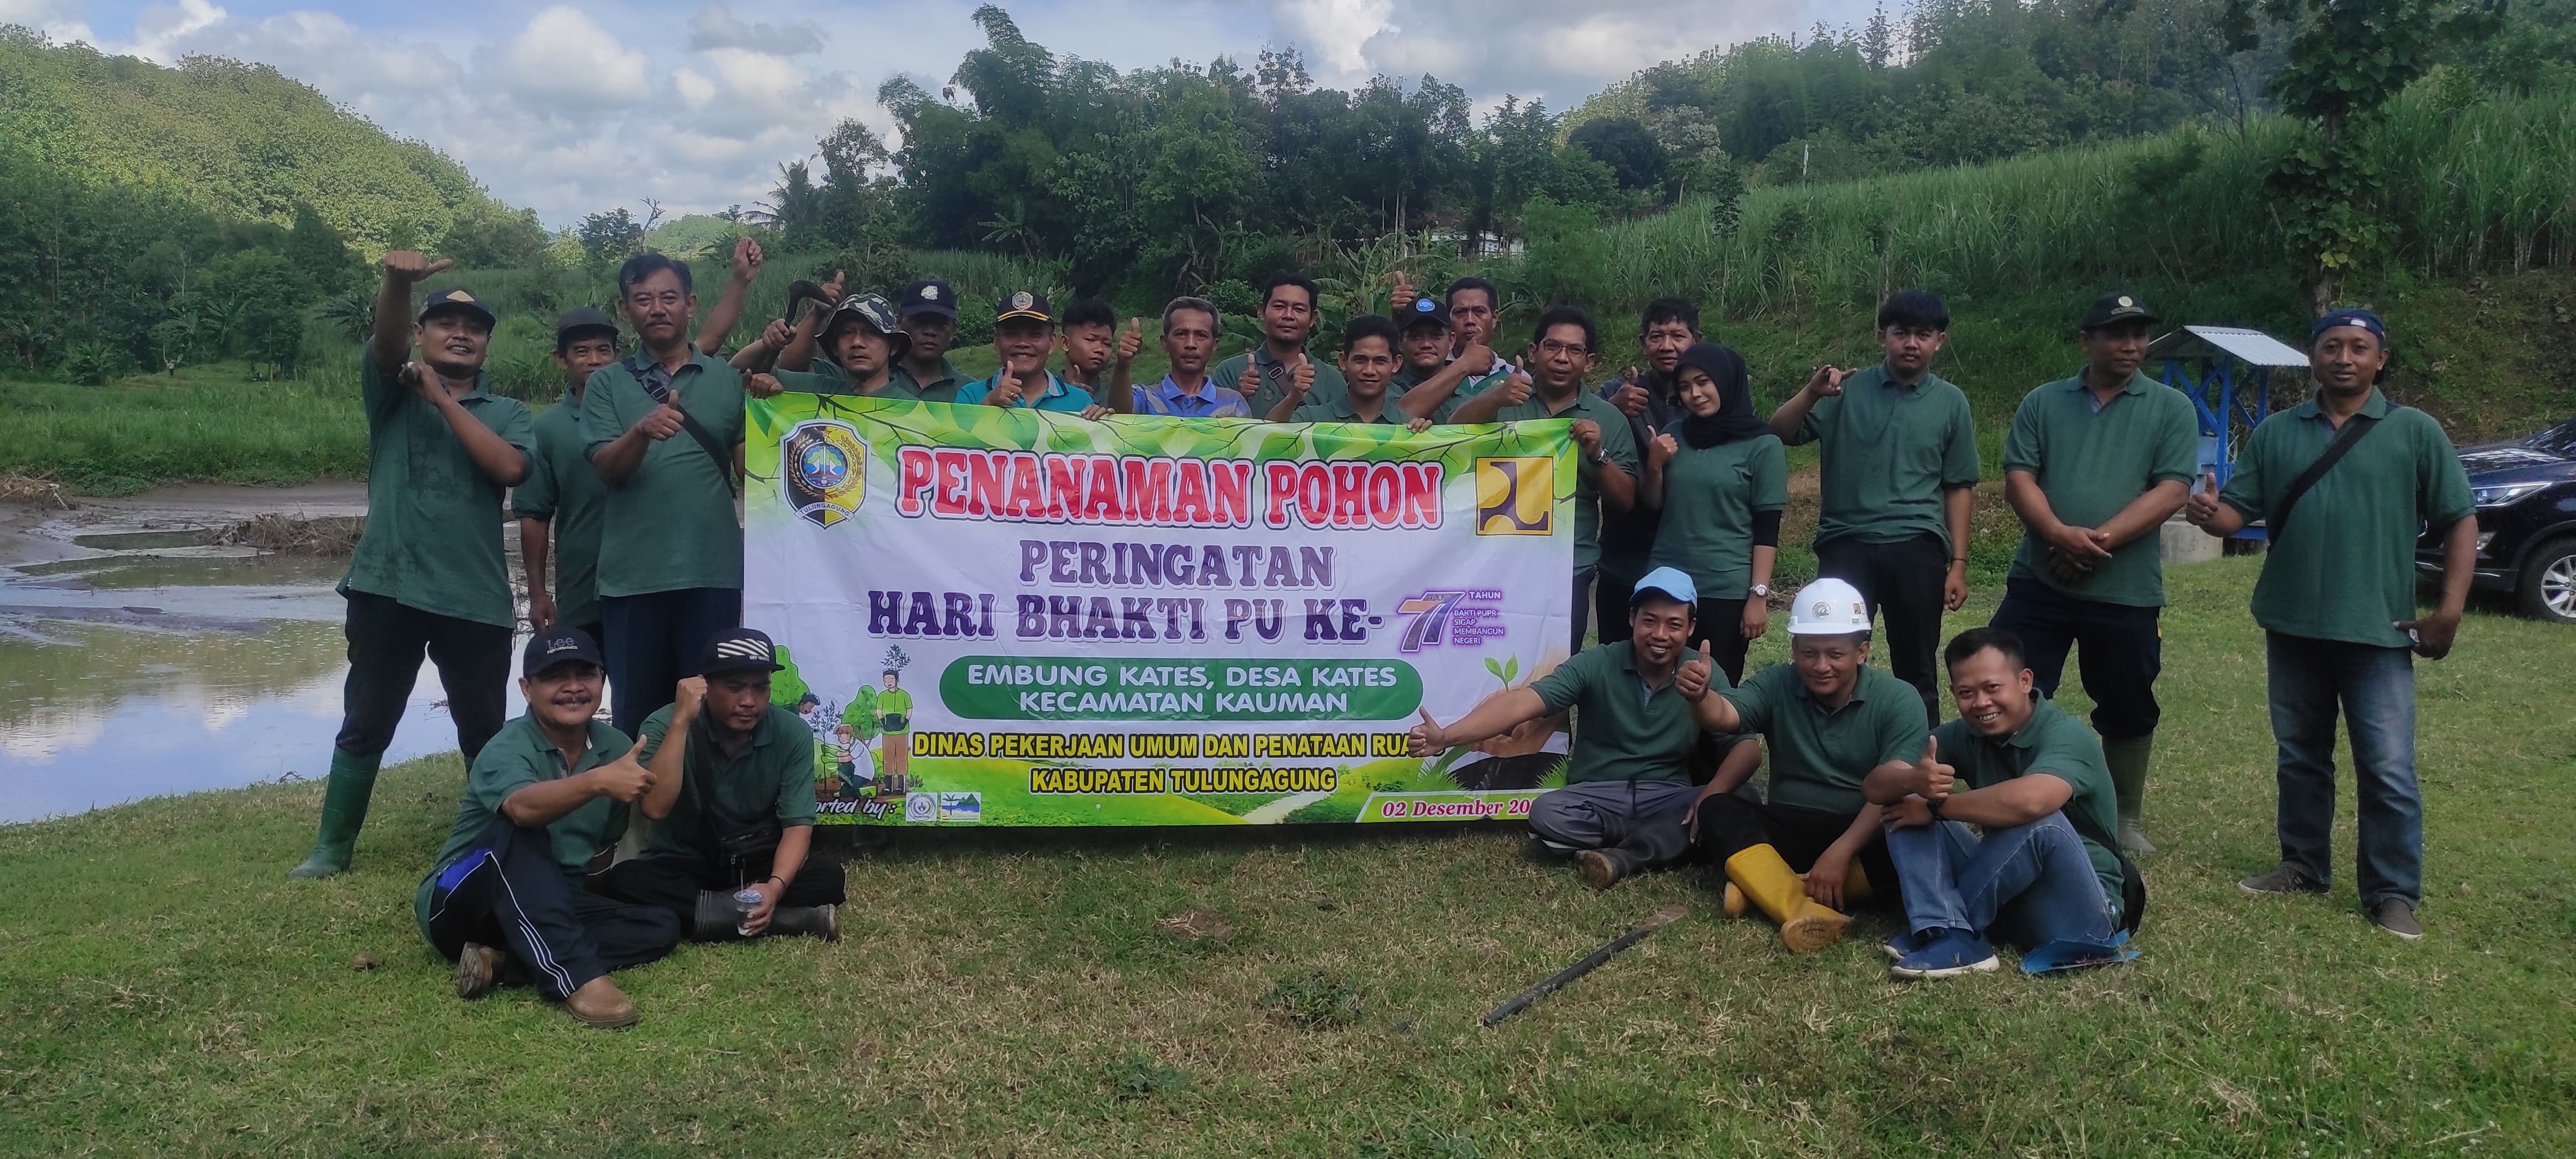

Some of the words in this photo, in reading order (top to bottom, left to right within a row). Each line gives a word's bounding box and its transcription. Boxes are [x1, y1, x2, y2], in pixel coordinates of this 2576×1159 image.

[900, 450, 1249, 524] PENANAMAN
[1267, 464, 1441, 525] POHON
[800, 502, 850, 517] TULUNGAGUNG
[1019, 540, 1334, 587] PERINGATAN
[867, 589, 995, 636] HARI
[1016, 594, 1204, 639] BHAKTI
[1225, 599, 1286, 640] PU
[1304, 599, 1382, 640] KE-
[546, 637, 575, 650] Lee
[968, 664, 1108, 686] EMBUNG
[1119, 666, 1215, 690] KATES,
[1226, 666, 1302, 687] DESA
[1312, 666, 1397, 687] KATES
[1020, 692, 1203, 713] KECAMATAN
[1216, 693, 1348, 713] KAUMAN
[914, 733, 983, 755] DINAS
[991, 734, 1123, 757] PEKERJAAN
[1130, 735, 1198, 757] UMUM
[1205, 735, 1249, 757] DAN
[1255, 735, 1367, 757] PENATAAN
[1032, 769, 1165, 792] KABUPATEN
[1170, 769, 1336, 792] TULUNGAGUNG
[863, 799, 887, 820] by
[1382, 802, 1406, 817] 02
[1412, 799, 1503, 816] Desember
[1508, 799, 1530, 814] 20
